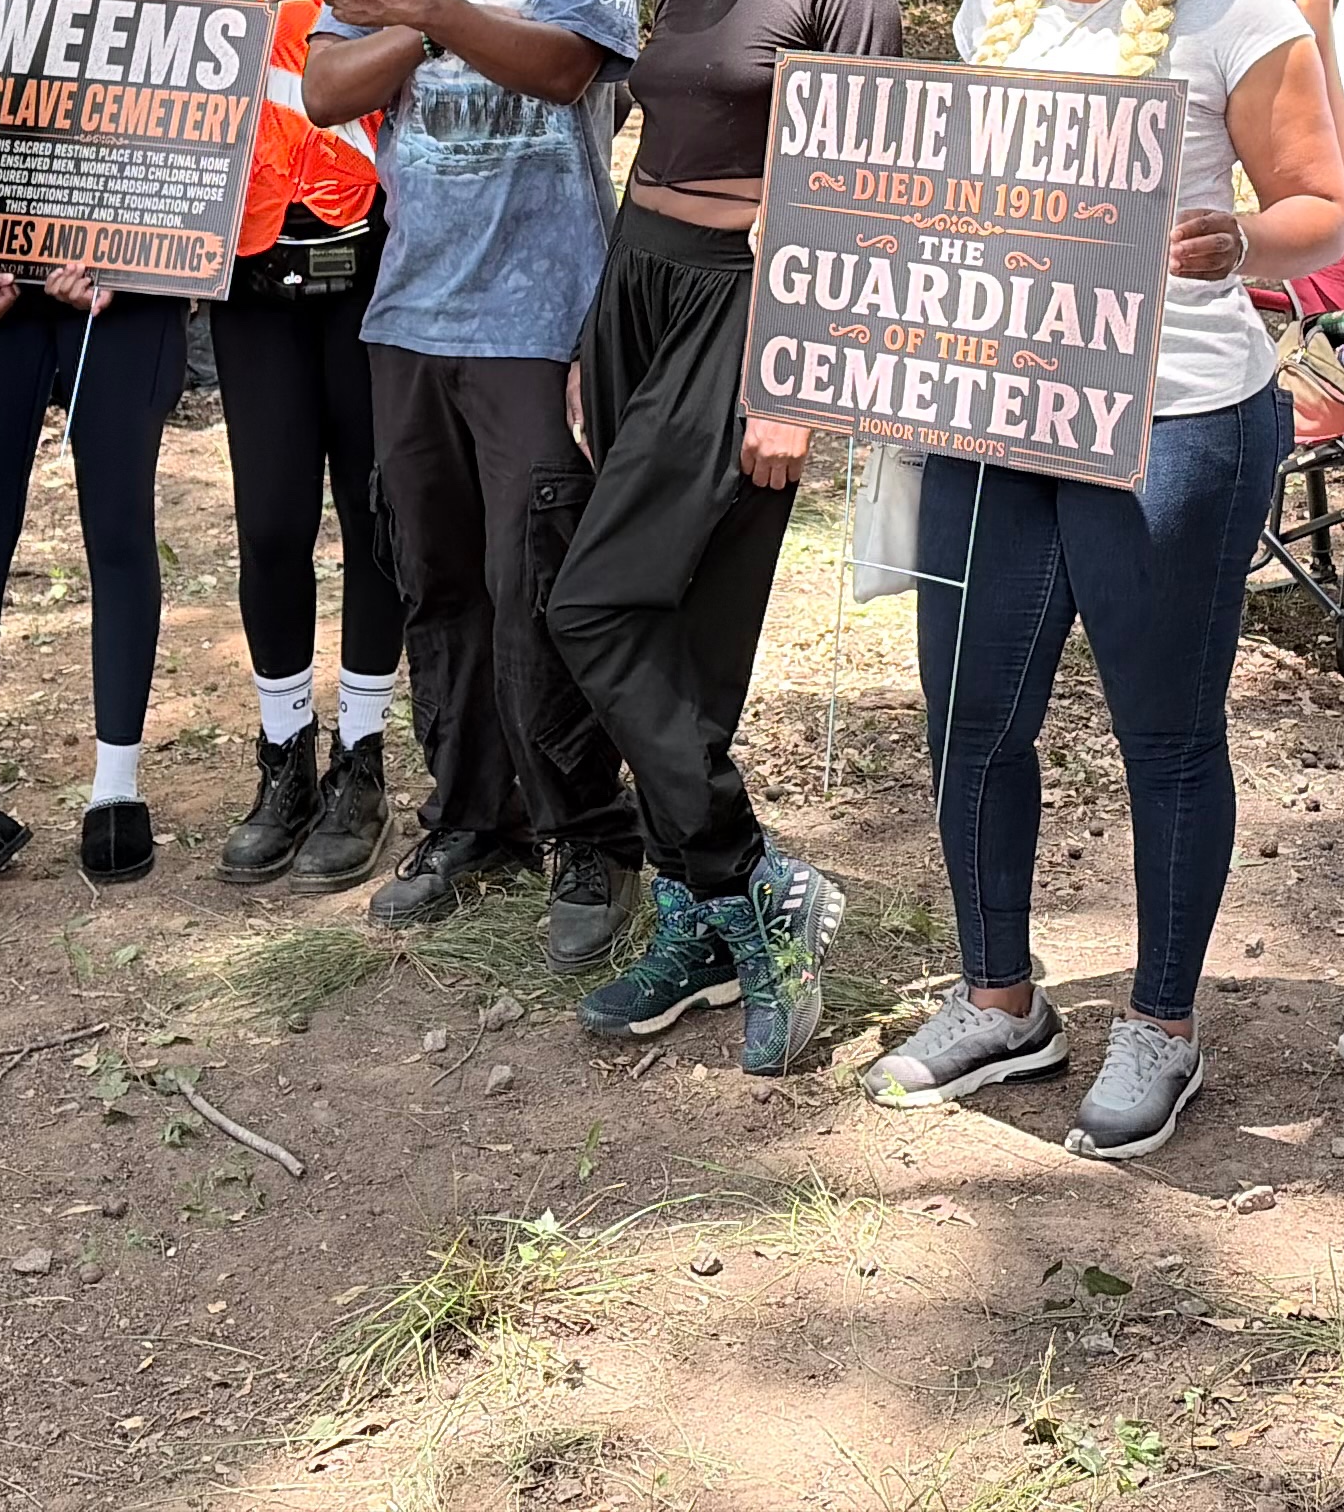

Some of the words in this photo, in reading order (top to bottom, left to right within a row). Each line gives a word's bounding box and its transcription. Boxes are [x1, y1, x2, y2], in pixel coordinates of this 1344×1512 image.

[81, 83, 249, 144] CEMETERY
[781, 70, 952, 172] SALLIE
[968, 84, 1168, 193] WEEMS
[0, 155, 50, 171] ENSLAVED
[52, 158, 77, 174] MEN,
[80, 161, 120, 177] WOMEN,
[123, 165, 146, 179] AND
[147, 167, 200, 184] CHILDREN
[202, 171, 227, 186] WHO
[13, 140, 52, 156] SACRED
[54, 143, 96, 160] RESTING
[98, 147, 131, 162] PLACE
[132, 150, 143, 163] IS
[146, 152, 166, 166] THE
[168, 154, 196, 169] FINAL
[199, 156, 231, 172] HOME
[31, 172, 105, 190] UNIMAGINABLE
[107, 178, 160, 195] HARDSHIP
[161, 183, 184, 198] AND
[186, 185, 225, 201] WHOSE
[71, 190, 101, 205] BUILT
[103, 192, 122, 208] THE
[124, 194, 190, 214] FOUNDATION
[192, 201, 206, 215] OF
[852, 168, 934, 208] DIED
[944, 178, 984, 214] IN
[994, 184, 1068, 224] 1910
[5, 200, 28, 214] THIS
[29, 201, 91, 219] COMMUNITY
[92, 206, 114, 221] AND
[117, 209, 140, 224] THIS
[143, 212, 184, 228] NATION.
[39, 223, 88, 261] AND
[92, 228, 205, 273] COUNTING
[918, 235, 985, 266] THE
[768, 244, 1145, 356] GUARDIAN
[884, 324, 927, 354] OF
[936, 332, 999, 367] THE
[760, 335, 1133, 457] CEMETERY
[859, 417, 914, 441] HONOR
[918, 428, 949, 449] THY
[953, 434, 1006, 458] ROOTS
